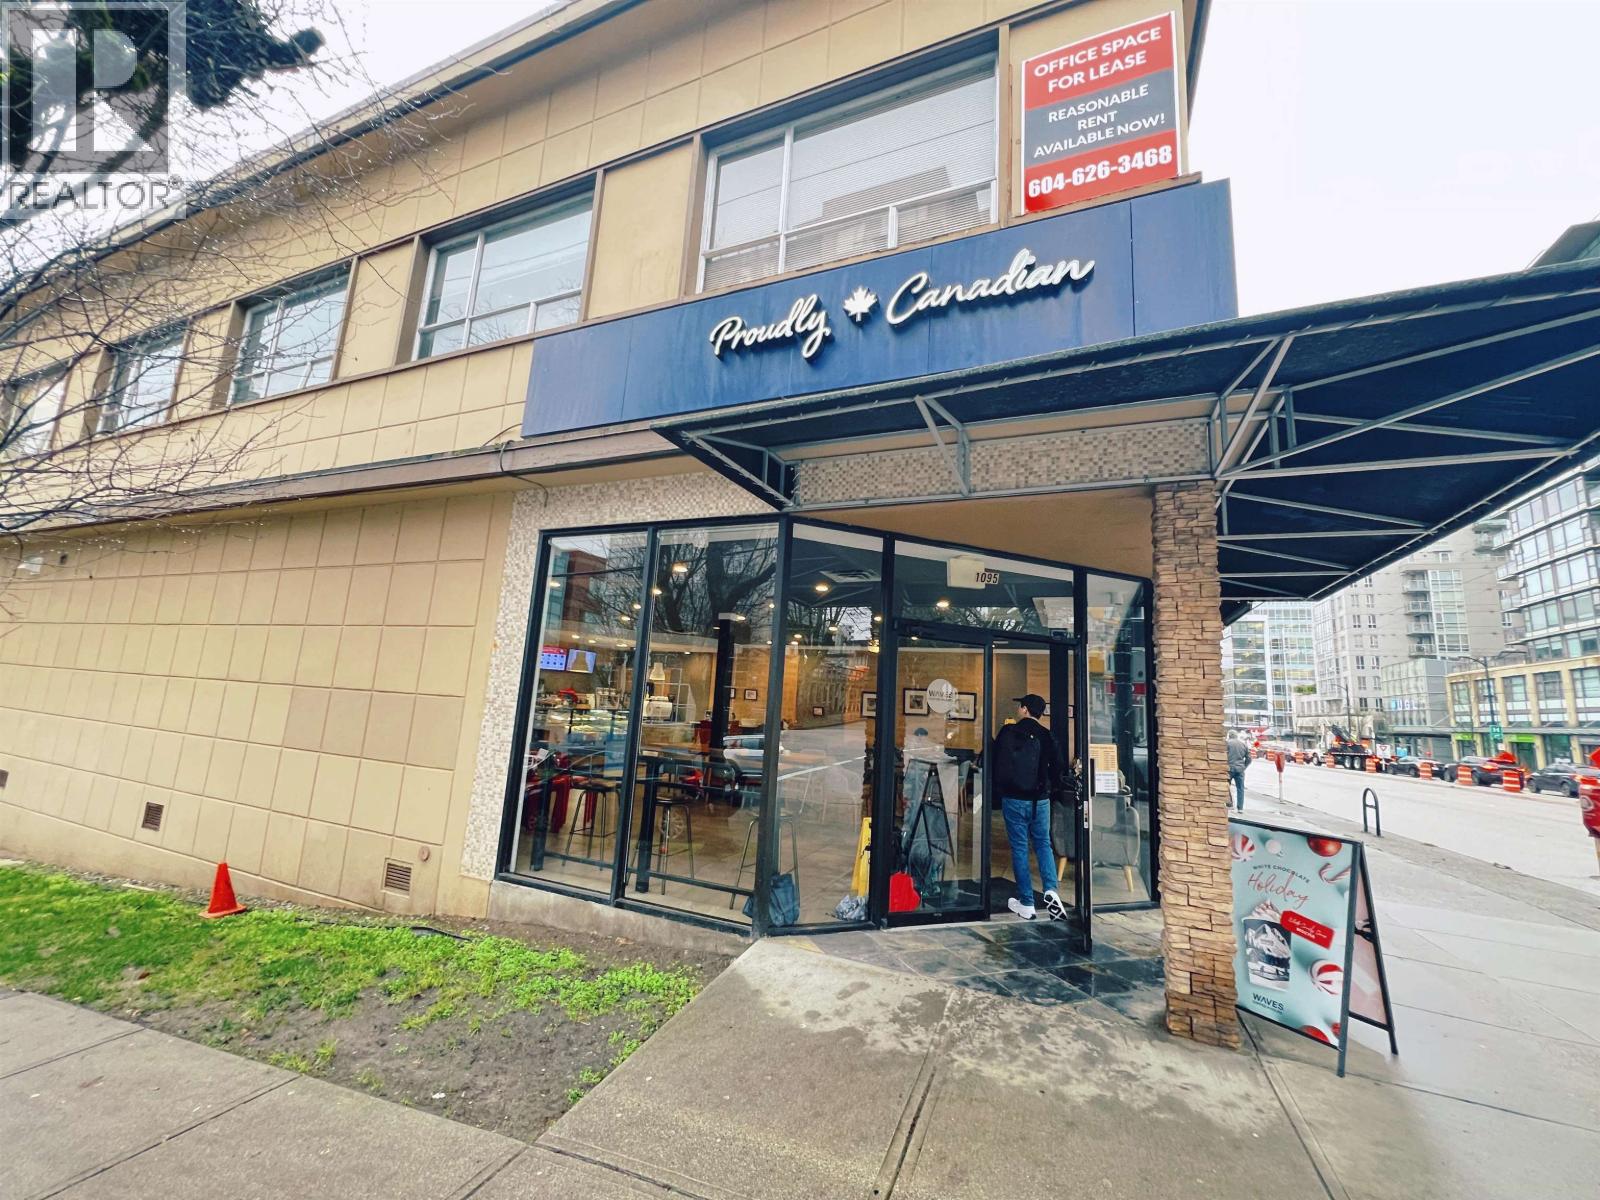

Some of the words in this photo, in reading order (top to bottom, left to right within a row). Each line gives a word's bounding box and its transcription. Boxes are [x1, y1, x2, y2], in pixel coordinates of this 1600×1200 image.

[1034, 47, 1098, 77] OFFICE
[1101, 27, 1162, 56] SPACE
[1048, 71, 1086, 93] FOR
[1089, 50, 1147, 81] LEASE
[1048, 84, 1149, 123] REASONABLE
[1077, 111, 1118, 131] RENT
[1033, 127, 1115, 158] AVAILABLE
[1117, 112, 1166, 136] NOW!
[1028, 144, 1173, 198] 604-626-3468
[709, 293, 831, 360] Proudly
[886, 248, 1095, 326] Canadian
[975, 572, 1000, 584] 1095
[1247, 871, 1310, 910] Holiday
[1252, 992, 1285, 1011] WAVES
